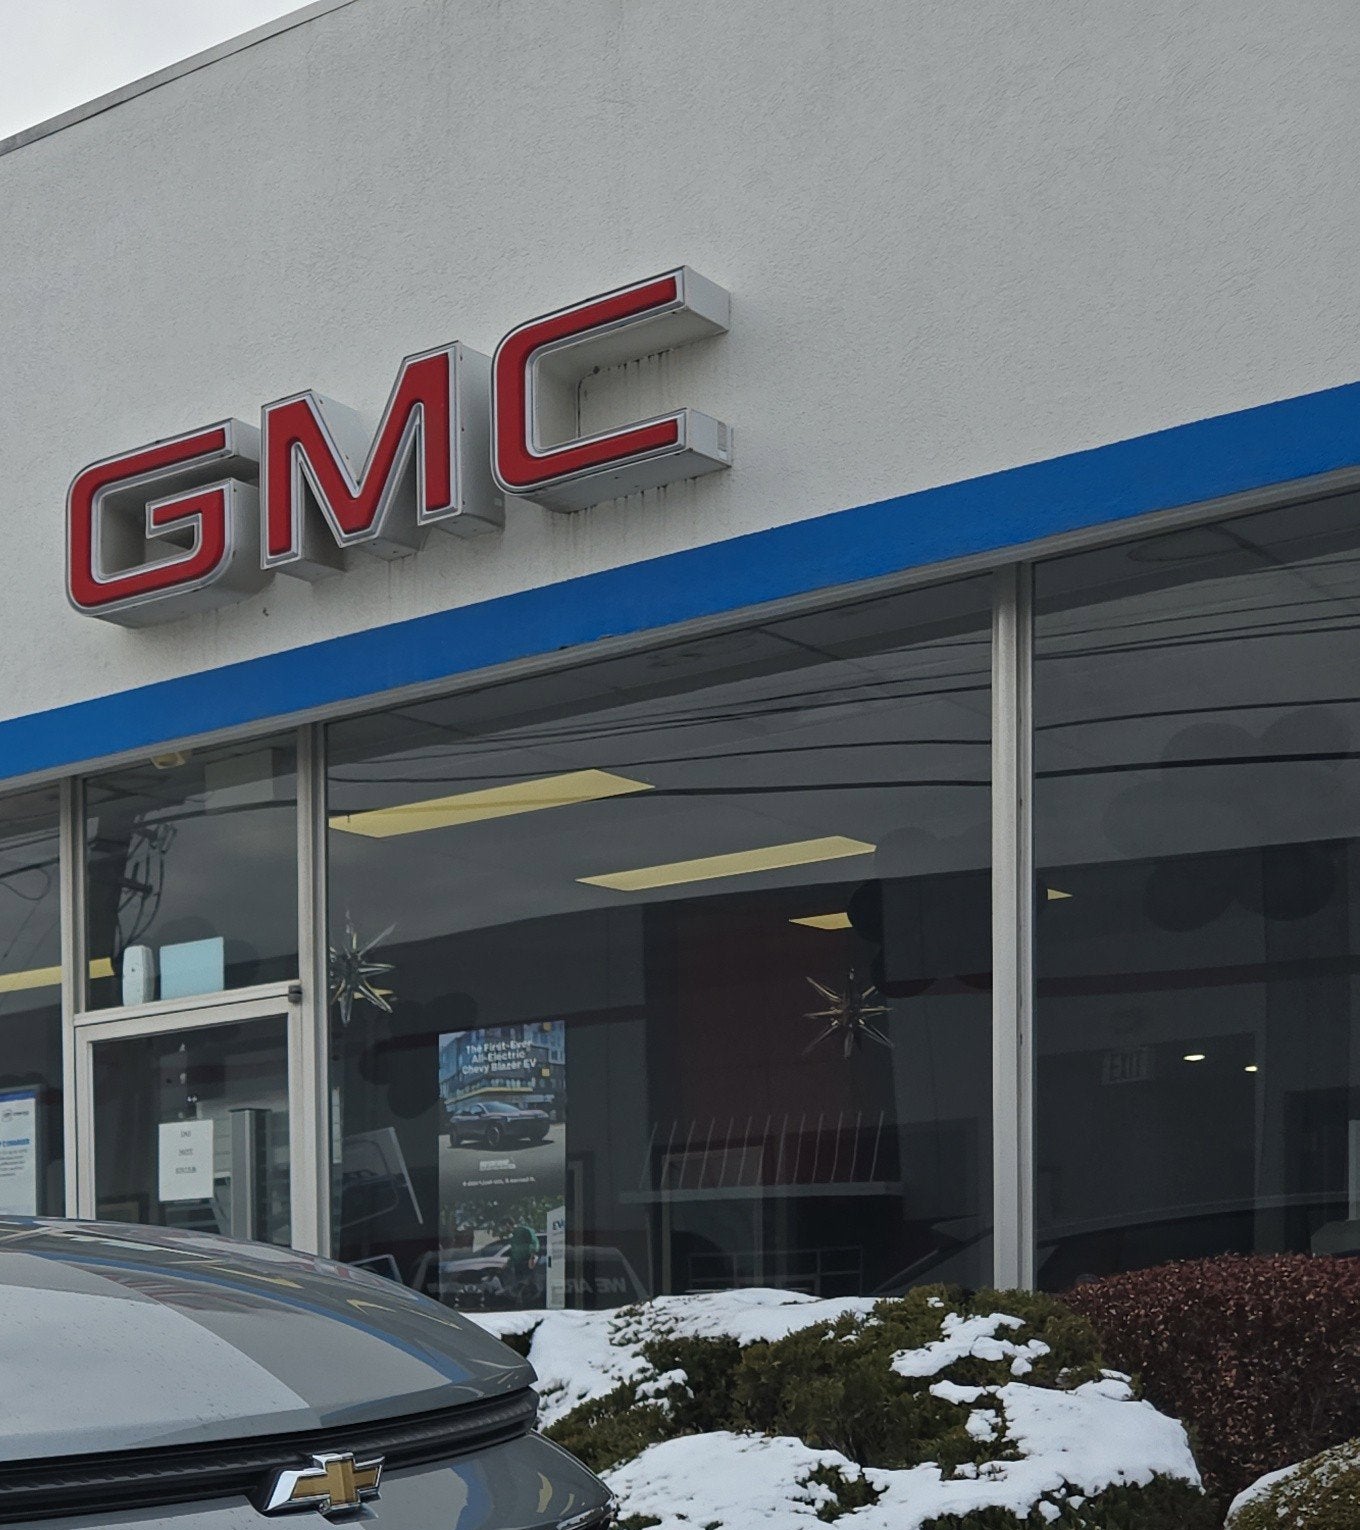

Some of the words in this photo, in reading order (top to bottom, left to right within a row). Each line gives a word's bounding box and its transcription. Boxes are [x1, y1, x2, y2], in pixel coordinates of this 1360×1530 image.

[66, 265, 692, 620] GMC
[466, 1045, 483, 1055] The
[471, 1050, 525, 1064] All-Electric
[462, 1063, 490, 1075] Chevy
[491, 1060, 521, 1072] Blazer
[523, 1057, 537, 1069] EV
